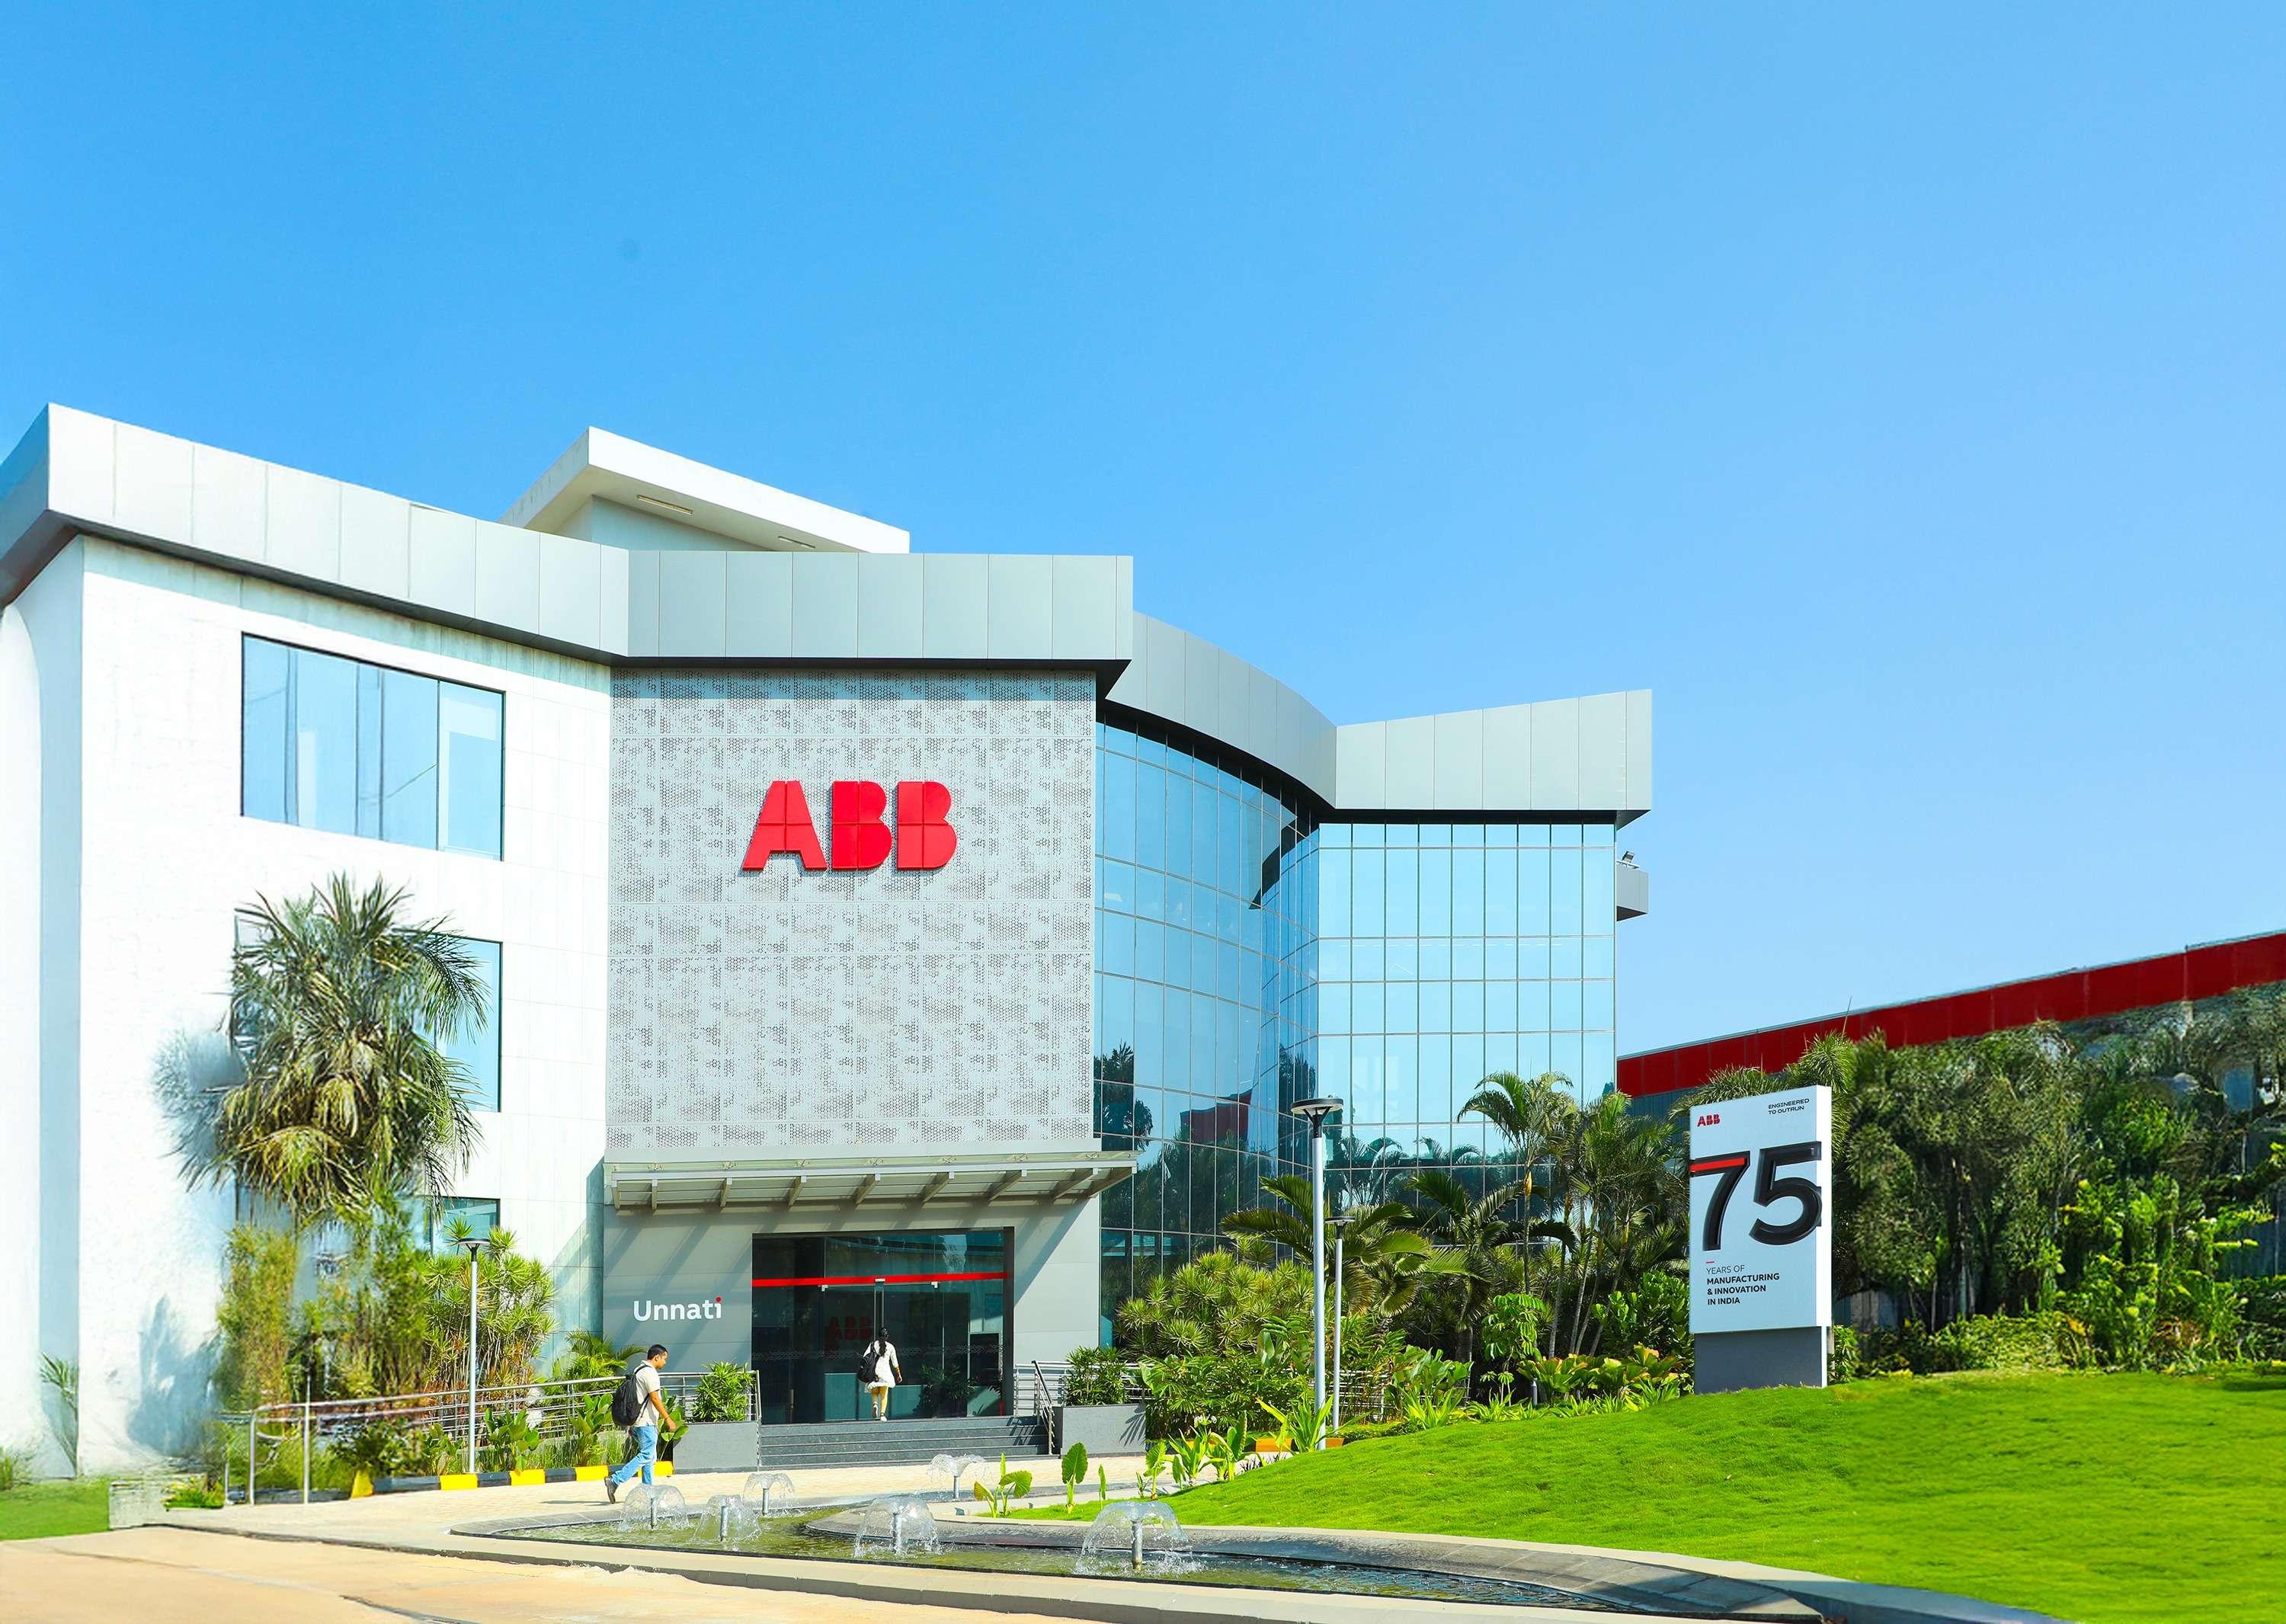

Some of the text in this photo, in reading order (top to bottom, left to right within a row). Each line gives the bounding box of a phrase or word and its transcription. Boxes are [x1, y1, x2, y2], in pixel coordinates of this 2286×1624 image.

[741, 780, 957, 870] ABB
[1768, 1098, 1810, 1110] ENGINEERED
[1778, 1106, 1804, 1114] OUTRUN
[1697, 1114, 1721, 1127] ABB
[1689, 1141, 1822, 1251] 75
[1706, 1266, 1731, 1275] YEARS
[1707, 1273, 1780, 1285] MANUFACTURING
[1714, 1285, 1766, 1295] INNOVATION
[633, 1296, 722, 1321] Unnati
